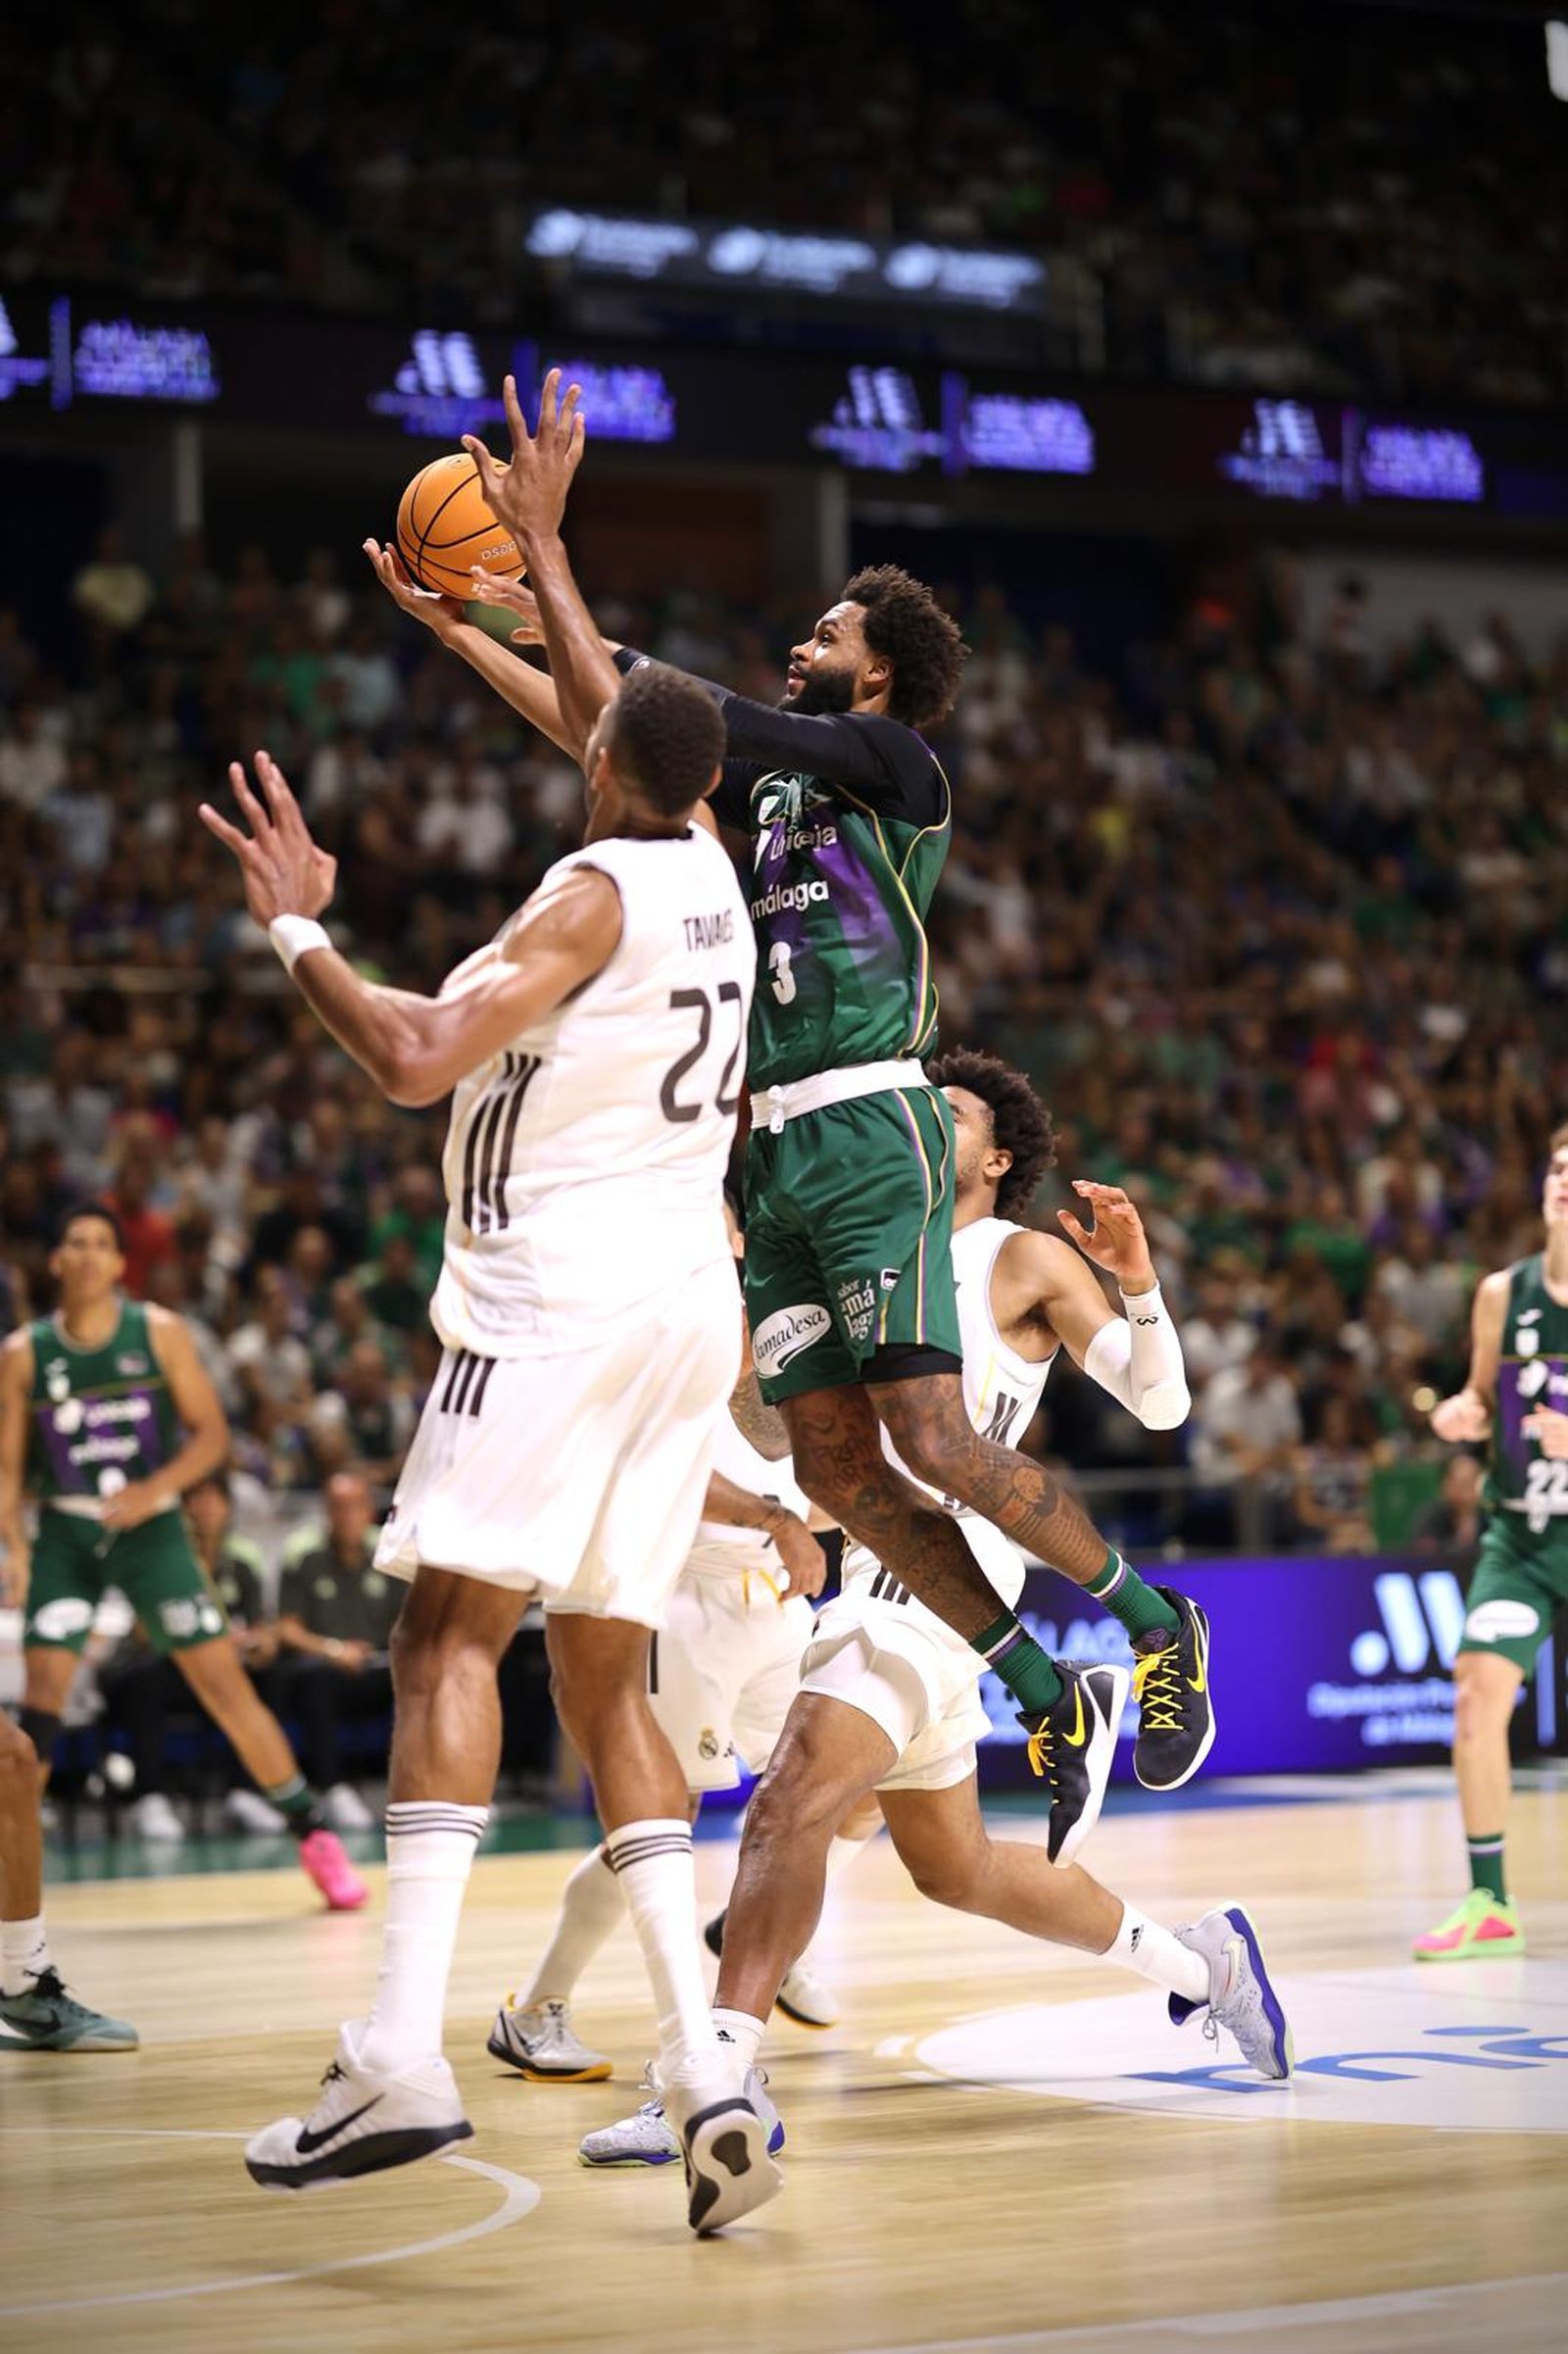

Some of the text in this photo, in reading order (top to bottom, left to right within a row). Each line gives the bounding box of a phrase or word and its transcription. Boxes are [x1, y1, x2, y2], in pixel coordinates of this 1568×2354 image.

[751, 881, 829, 919] málaga
[768, 941, 797, 1005] 3
[660, 981, 741, 1123] 22
[754, 1310, 826, 1360] amadesa
